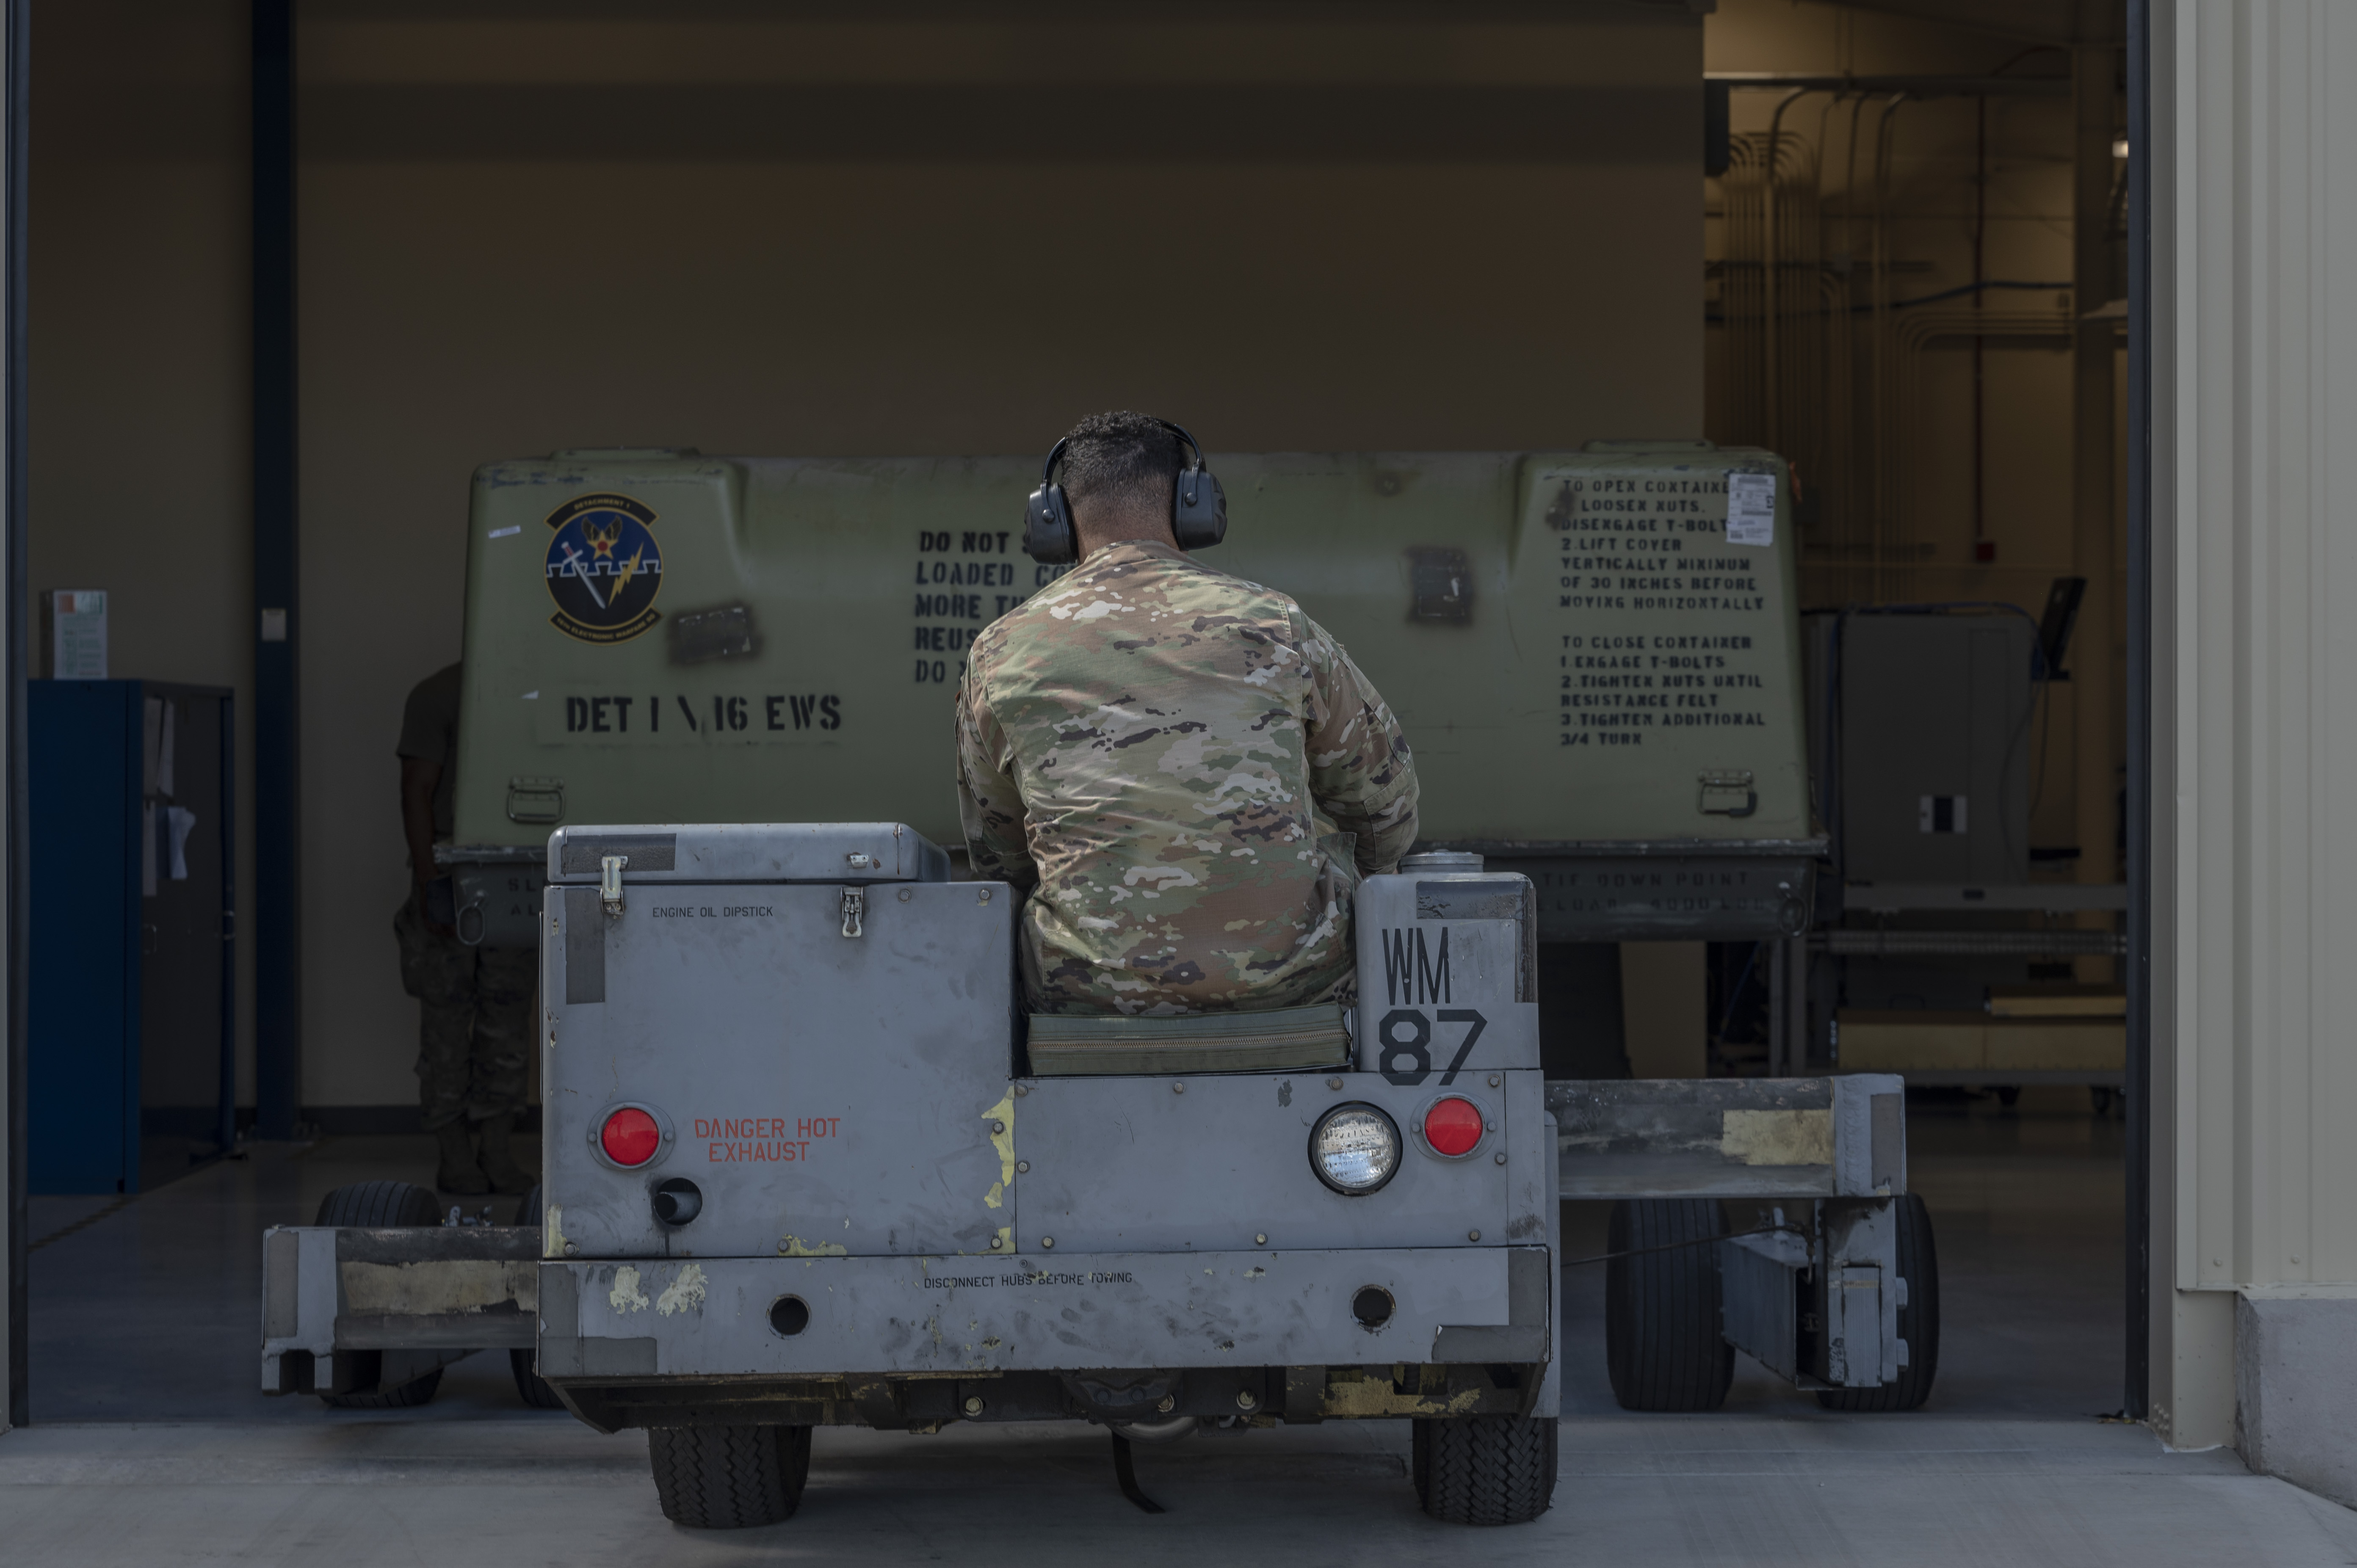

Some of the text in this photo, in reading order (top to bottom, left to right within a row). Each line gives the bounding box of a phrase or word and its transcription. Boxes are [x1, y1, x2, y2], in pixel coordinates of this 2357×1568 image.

[920, 530, 951, 552] DO
[961, 530, 1010, 554] NOT
[1625, 538, 1682, 552] COVER
[1561, 557, 1668, 571] VERTICALLY
[915, 560, 1014, 587] LOADED
[1560, 575, 1581, 589] OF
[1590, 576, 1611, 589] 30
[1691, 577, 1757, 592] BEFORE
[914, 593, 982, 620] MORE
[1562, 635, 1752, 650] TO CLOSE CONTAINER
[1650, 654, 1725, 670] T-BOLTS
[915, 659, 946, 684] DO
[1662, 674, 1705, 688] NUTS
[1713, 674, 1763, 688] UNTIL
[1561, 693, 1718, 708] RESISTANCE FELT
[566, 696, 633, 733] DET
[765, 694, 841, 731] EWS
[1662, 712, 1765, 726] ADDITIONAL
[1561, 732, 1589, 746] 3/4
[1675, 872, 1747, 886] POINT
[652, 906, 774, 918] ENGINE OIL DIPSTICK
[1382, 927, 1451, 1005] WM
[1379, 1009, 1487, 1086] 87
[694, 1118, 840, 1139] DANGER HOT
[709, 1141, 810, 1162] EXHAUST
[924, 1272, 1133, 1289] DISCONNECT HUBS BEFORE TOWING
